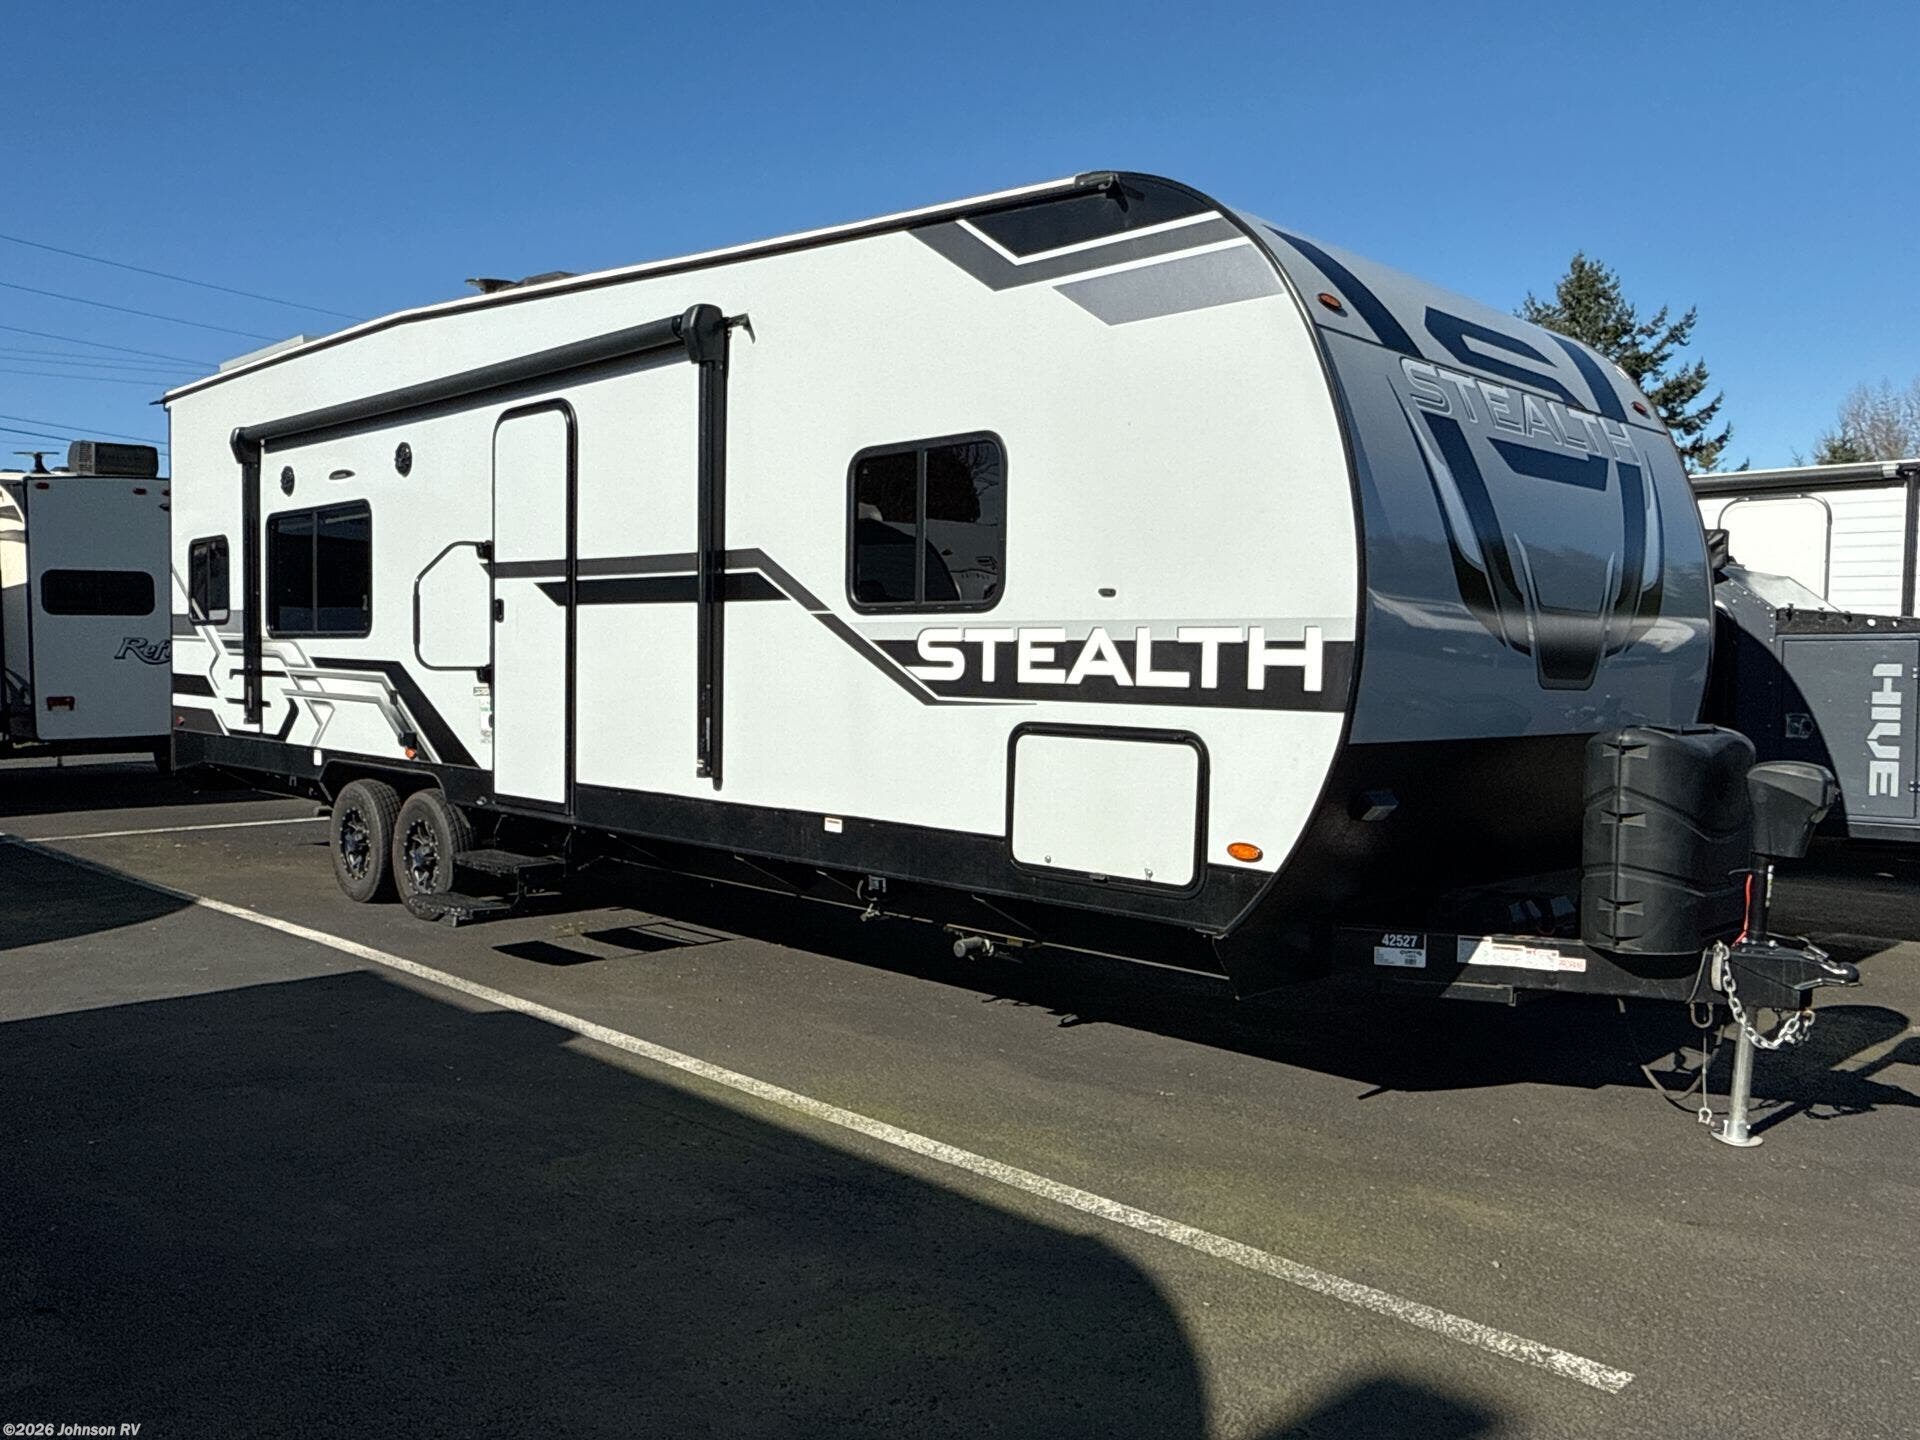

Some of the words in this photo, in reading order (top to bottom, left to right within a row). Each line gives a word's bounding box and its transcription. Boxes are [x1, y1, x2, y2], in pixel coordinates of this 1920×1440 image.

[1400, 357, 1641, 466] STEALTH
[904, 625, 1323, 692] STEALTH
[1866, 663, 1903, 798] HIVE
[1382, 934, 1417, 948] 42527
